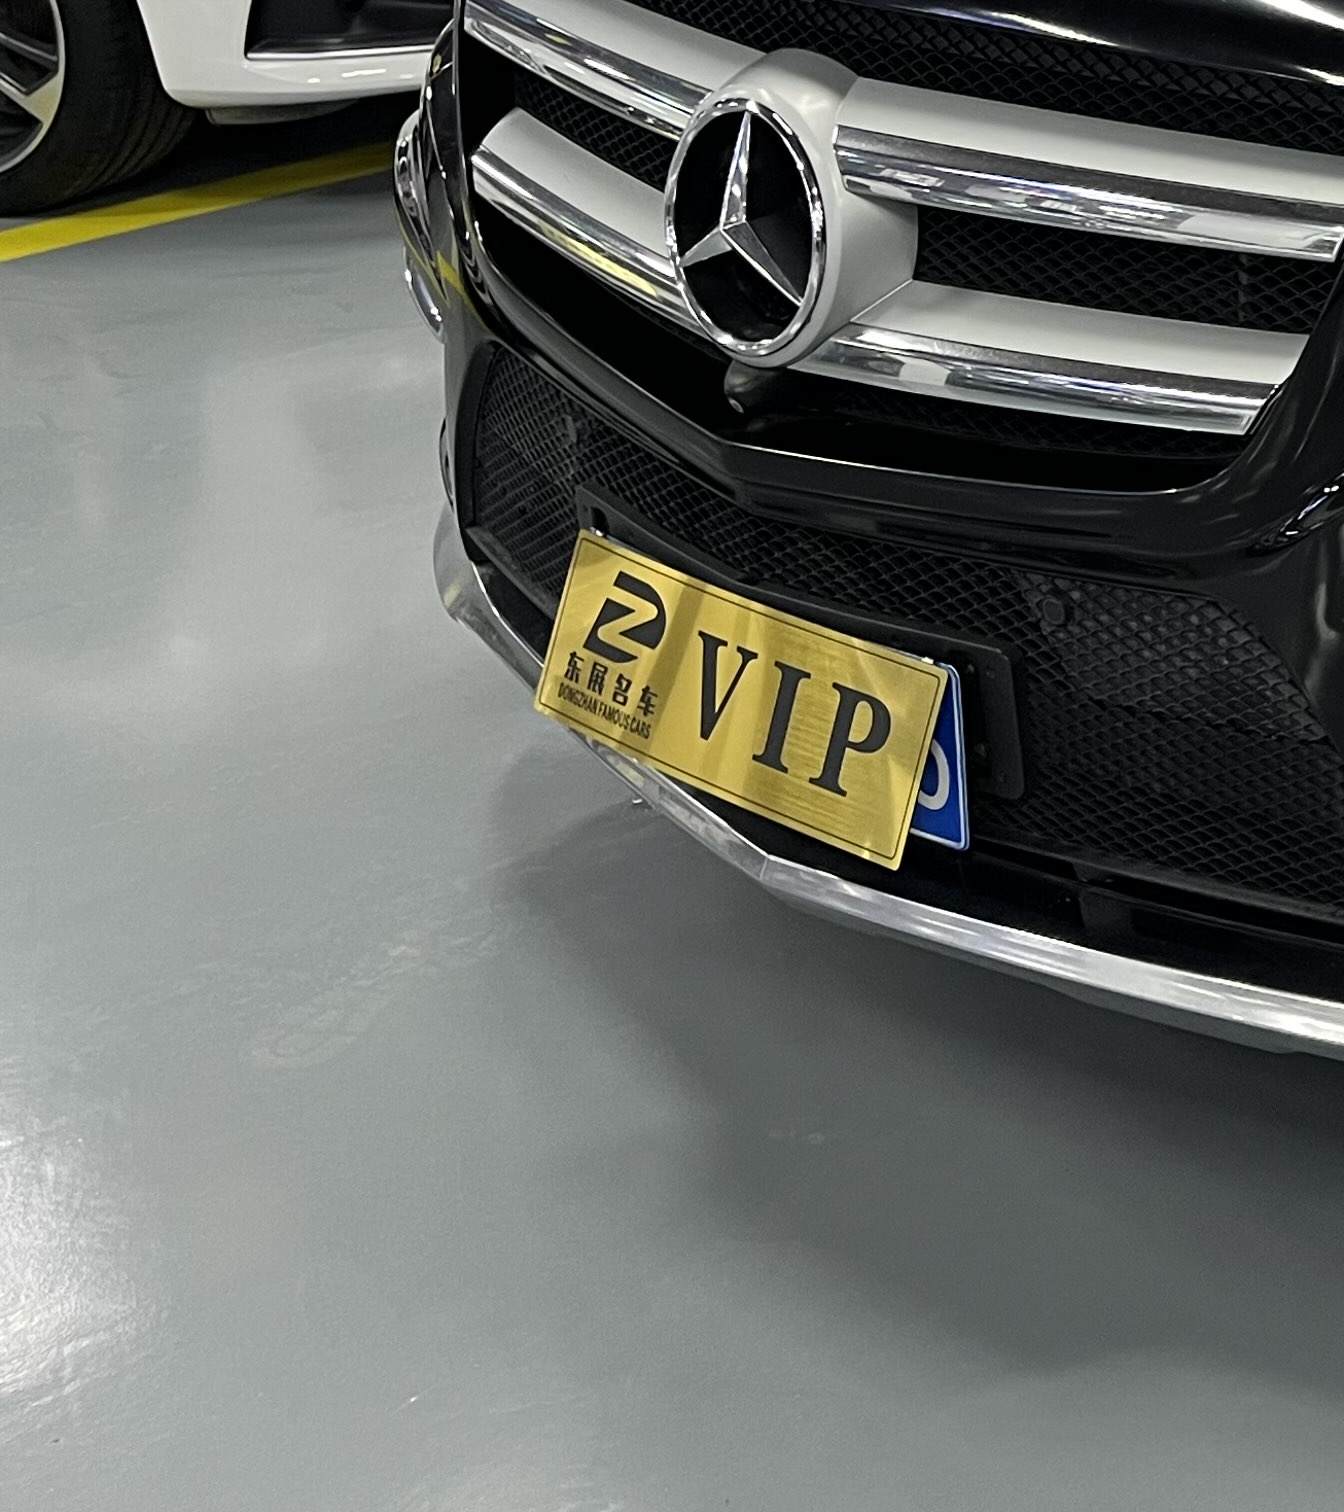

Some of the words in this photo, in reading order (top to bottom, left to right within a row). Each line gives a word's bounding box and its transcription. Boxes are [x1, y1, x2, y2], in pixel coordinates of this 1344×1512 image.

[563, 650, 659, 718] 东展名车
[697, 630, 892, 797] VIP
[597, 700, 631, 731] FAMOUS
[629, 715, 652, 740] CARS
